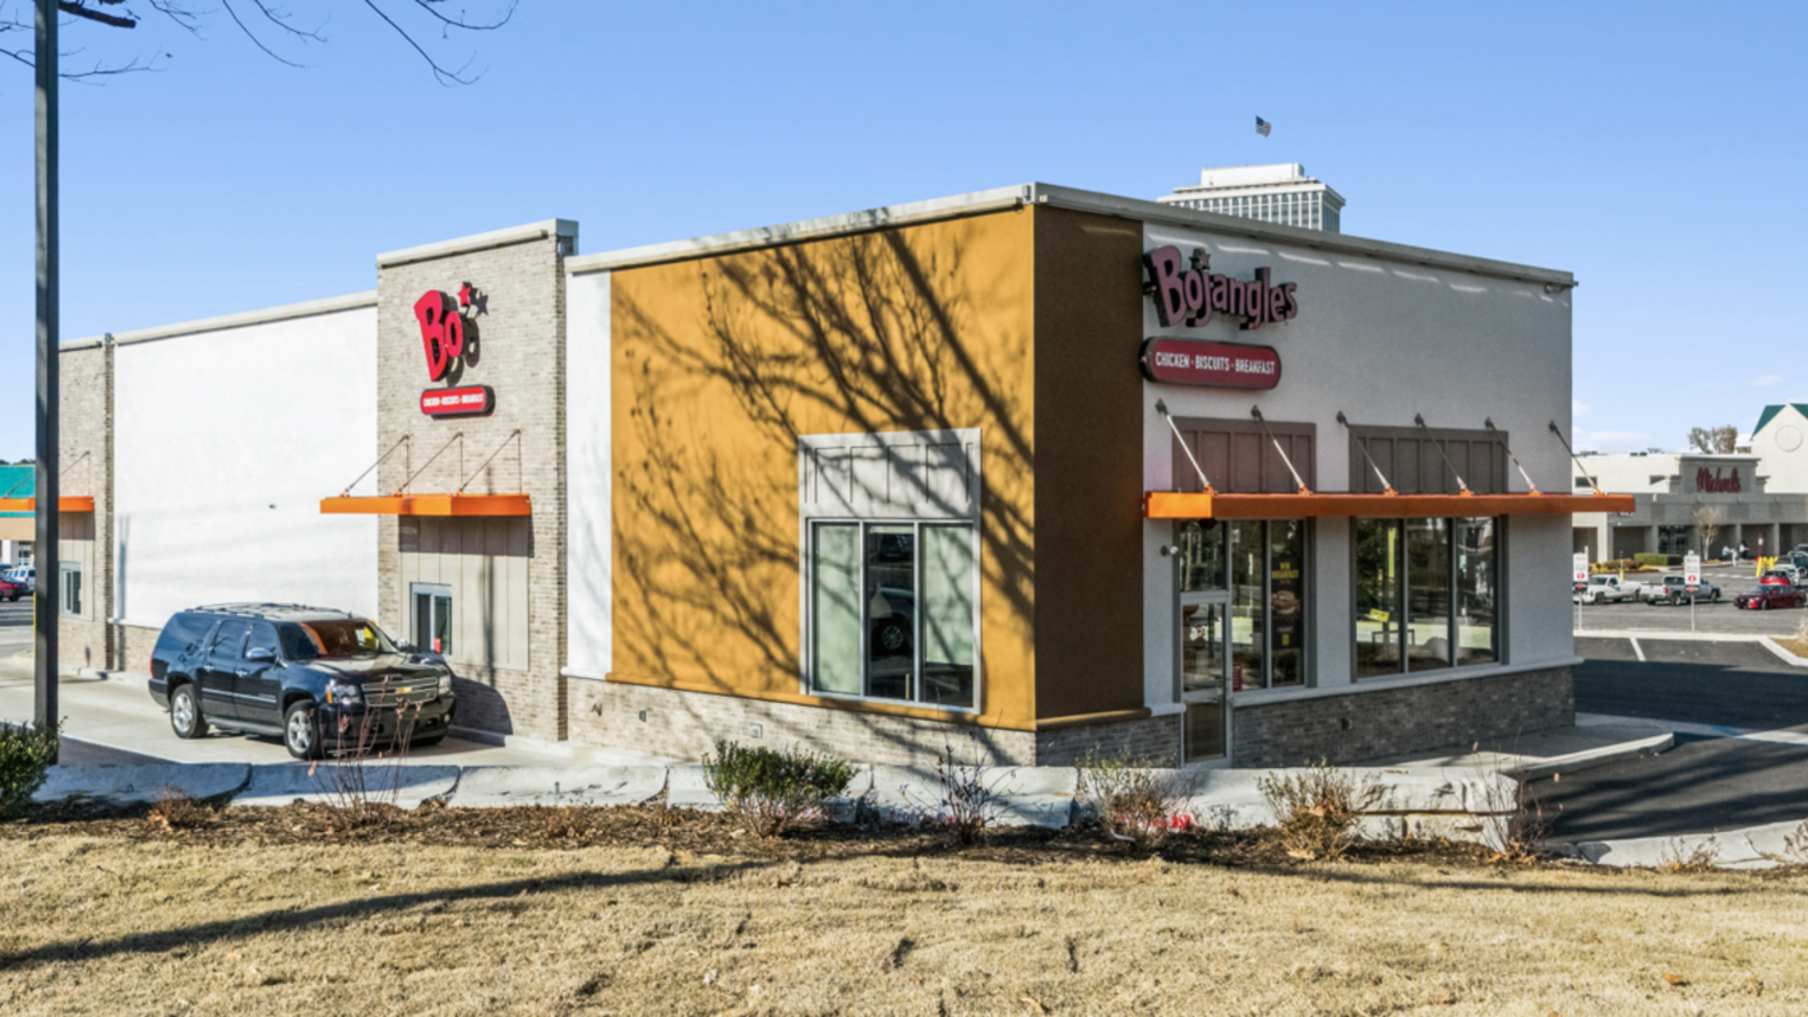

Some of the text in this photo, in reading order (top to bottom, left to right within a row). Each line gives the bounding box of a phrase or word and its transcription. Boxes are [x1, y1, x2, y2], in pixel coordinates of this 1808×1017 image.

[1150, 245, 1297, 329] Bojangles
[1155, 352, 1275, 374] CHICKEN BISCUITS BREAKFAST
